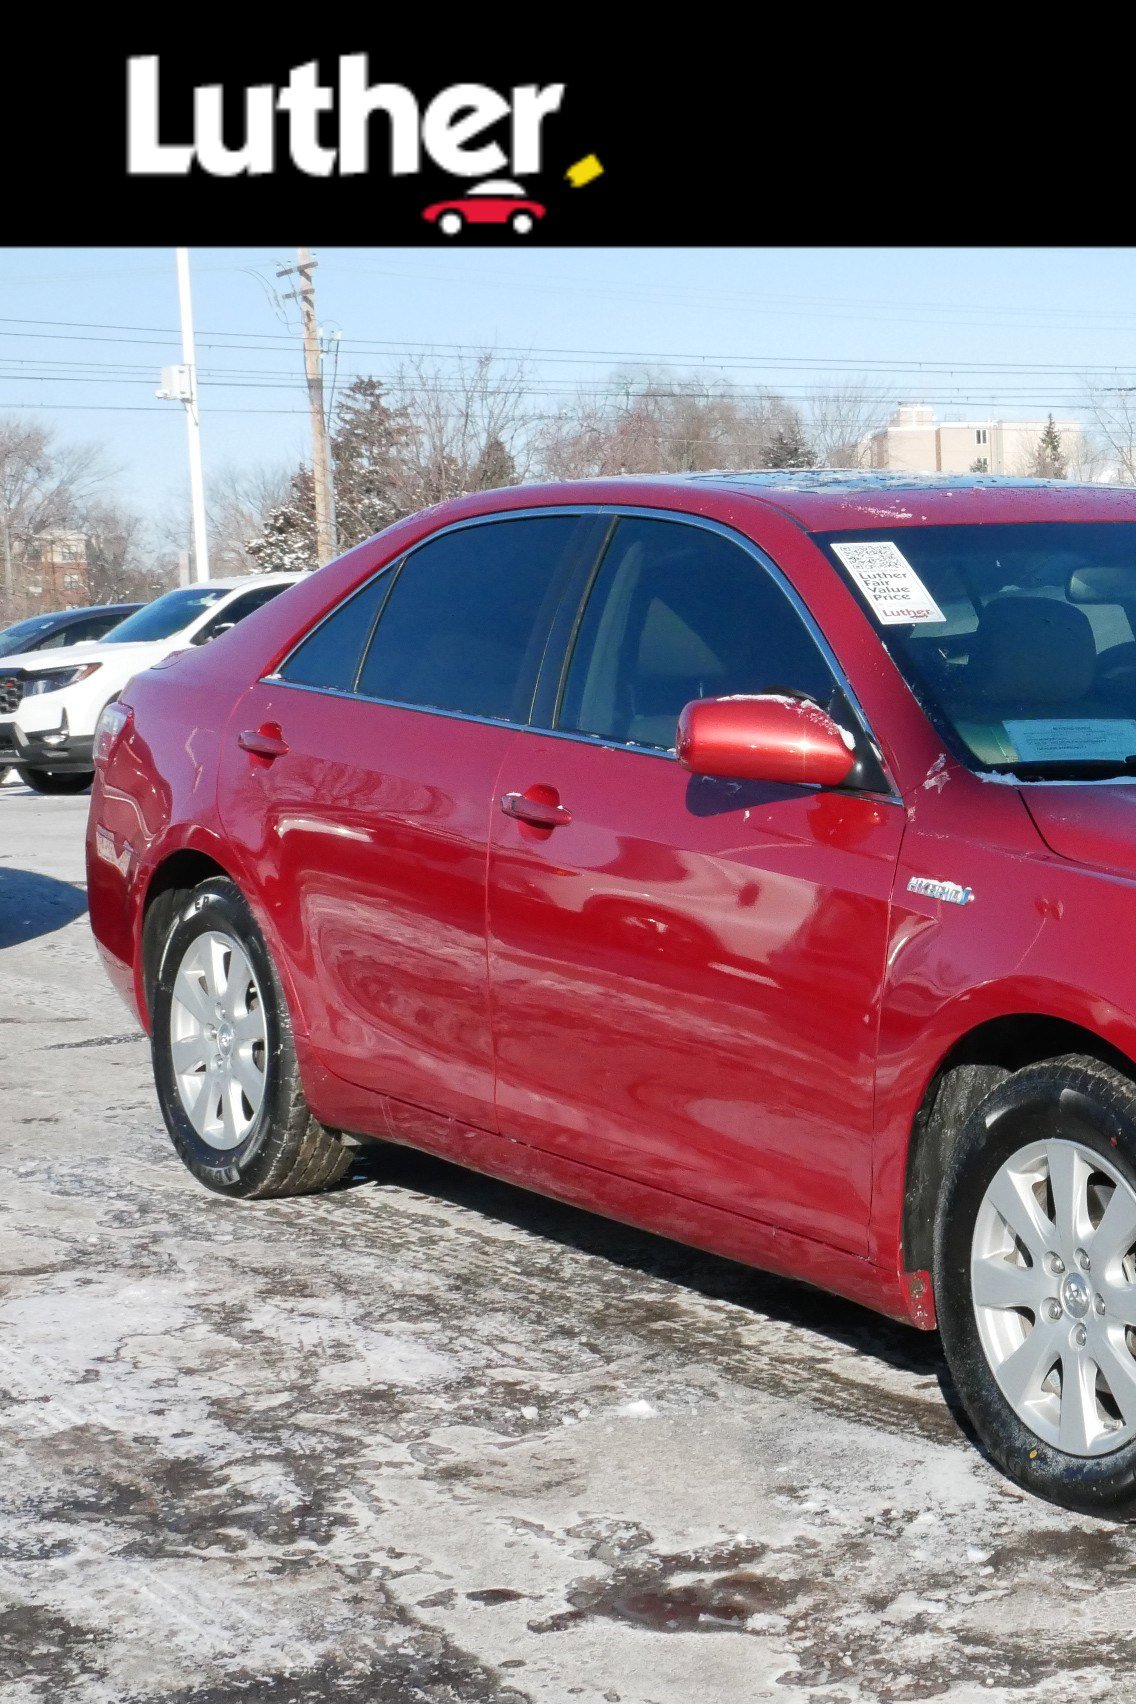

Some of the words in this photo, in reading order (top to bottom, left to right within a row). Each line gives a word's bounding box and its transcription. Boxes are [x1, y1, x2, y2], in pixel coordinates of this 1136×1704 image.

[859, 572, 908, 580] Luther
[863, 579, 890, 587] Fair
[867, 586, 911, 594] Value
[882, 608, 931, 617] Luther
